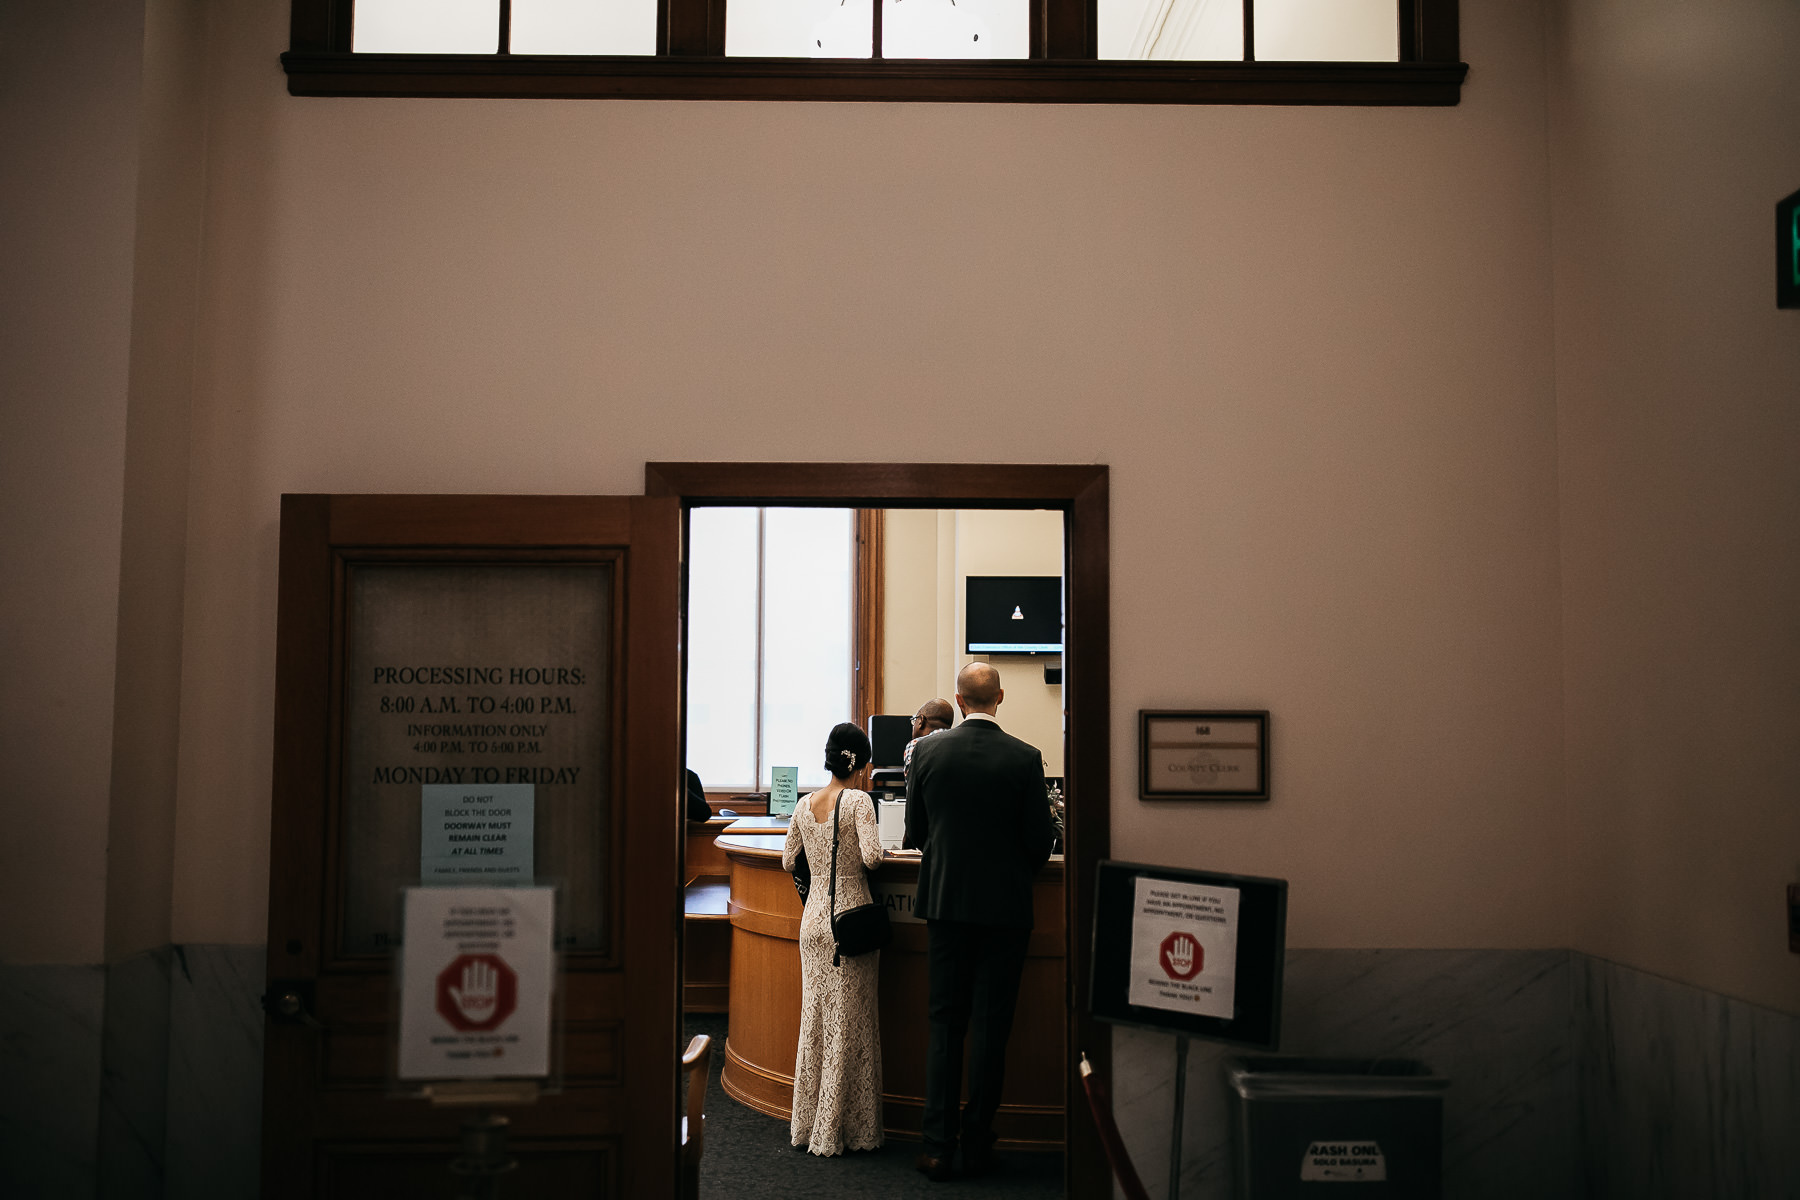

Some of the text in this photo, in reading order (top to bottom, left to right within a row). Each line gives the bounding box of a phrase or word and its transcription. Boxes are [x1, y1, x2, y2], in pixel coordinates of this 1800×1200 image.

[373, 667, 586, 685] PROCESSING HOURS:
[380, 696, 577, 714] 8:00 A.M. TO 4:00 P.M.
[407, 724, 548, 737] INFORMATION ONLY
[413, 741, 542, 754] 4:00 P.M. TO 5:00 P.M.
[372, 766, 581, 785] MONDAY TO FRIDAY
[462, 796, 493, 804] DO NOT
[444, 809, 512, 817] BLOCK THE DOOR
[444, 822, 512, 830] DOORWAY MUST
[448, 834, 507, 842] REMAIN CLEAR
[451, 847, 504, 855] AT ALL TIMES
[1172, 958, 1193, 967] STOP
[1313, 1158, 1377, 1166] SOLO BASURA
